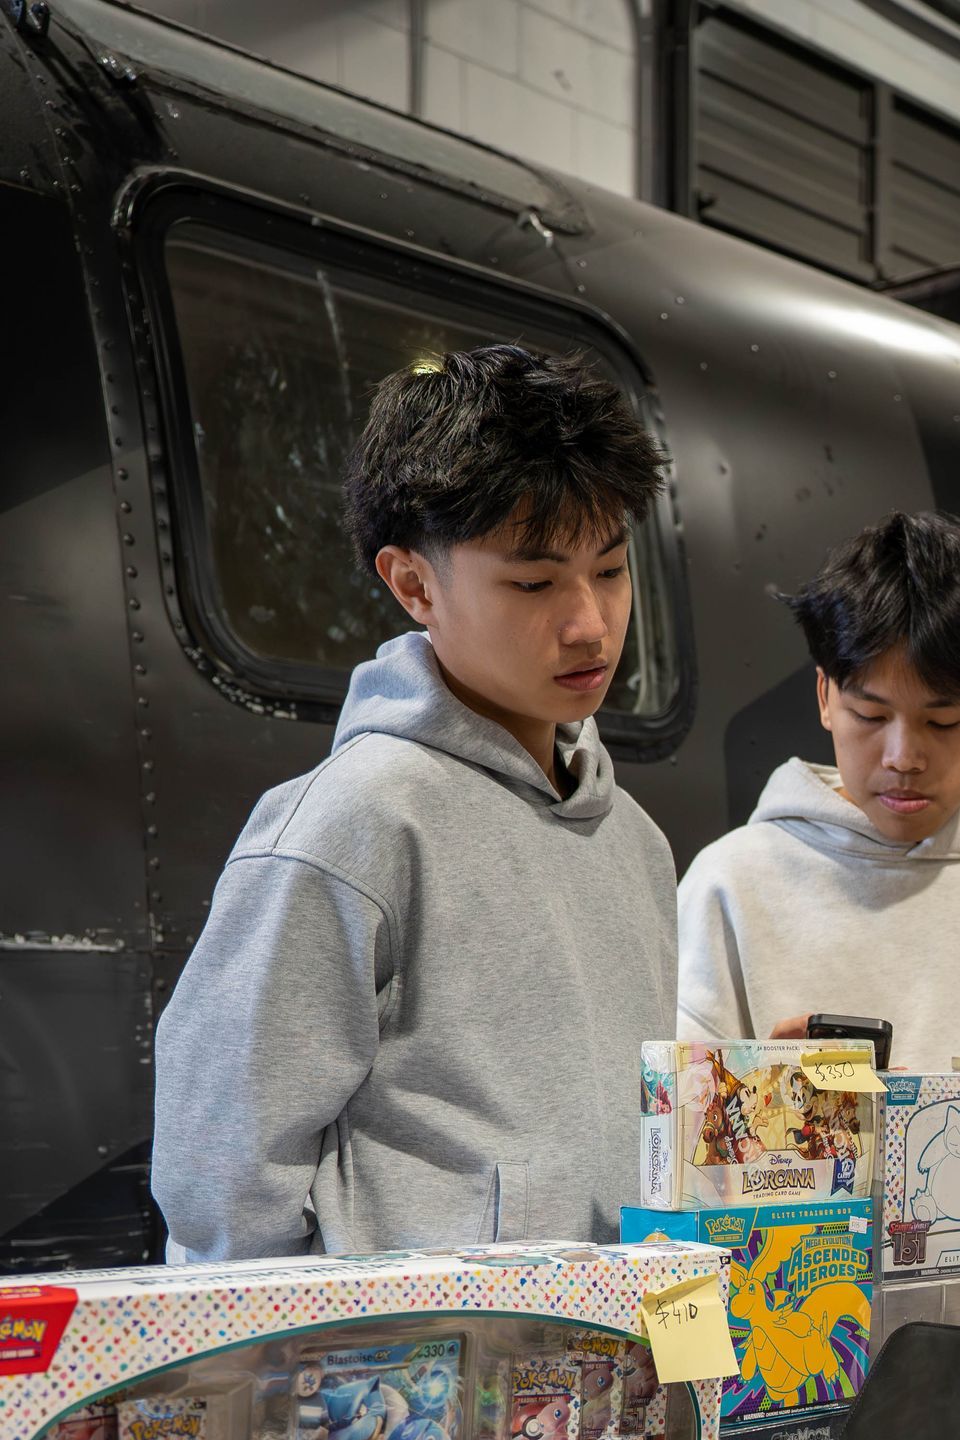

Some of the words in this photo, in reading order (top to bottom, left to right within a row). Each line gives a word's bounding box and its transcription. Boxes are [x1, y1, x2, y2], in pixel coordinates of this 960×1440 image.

[768, 1153, 793, 1166] Disney
[742, 1166, 816, 1195] LORCANA
[705, 1214, 745, 1235] POKéMON
[805, 1238, 821, 1250] MEGA
[822, 1235, 853, 1247] EVOLUTION
[893, 1232, 927, 1266] 151
[790, 1248, 868, 1277] ASCENDED
[799, 1263, 856, 1291] HEROES
[654, 1301, 698, 1329] $410
[424, 1344, 445, 1358] 330
[511, 1368, 577, 1391] POKéMON
